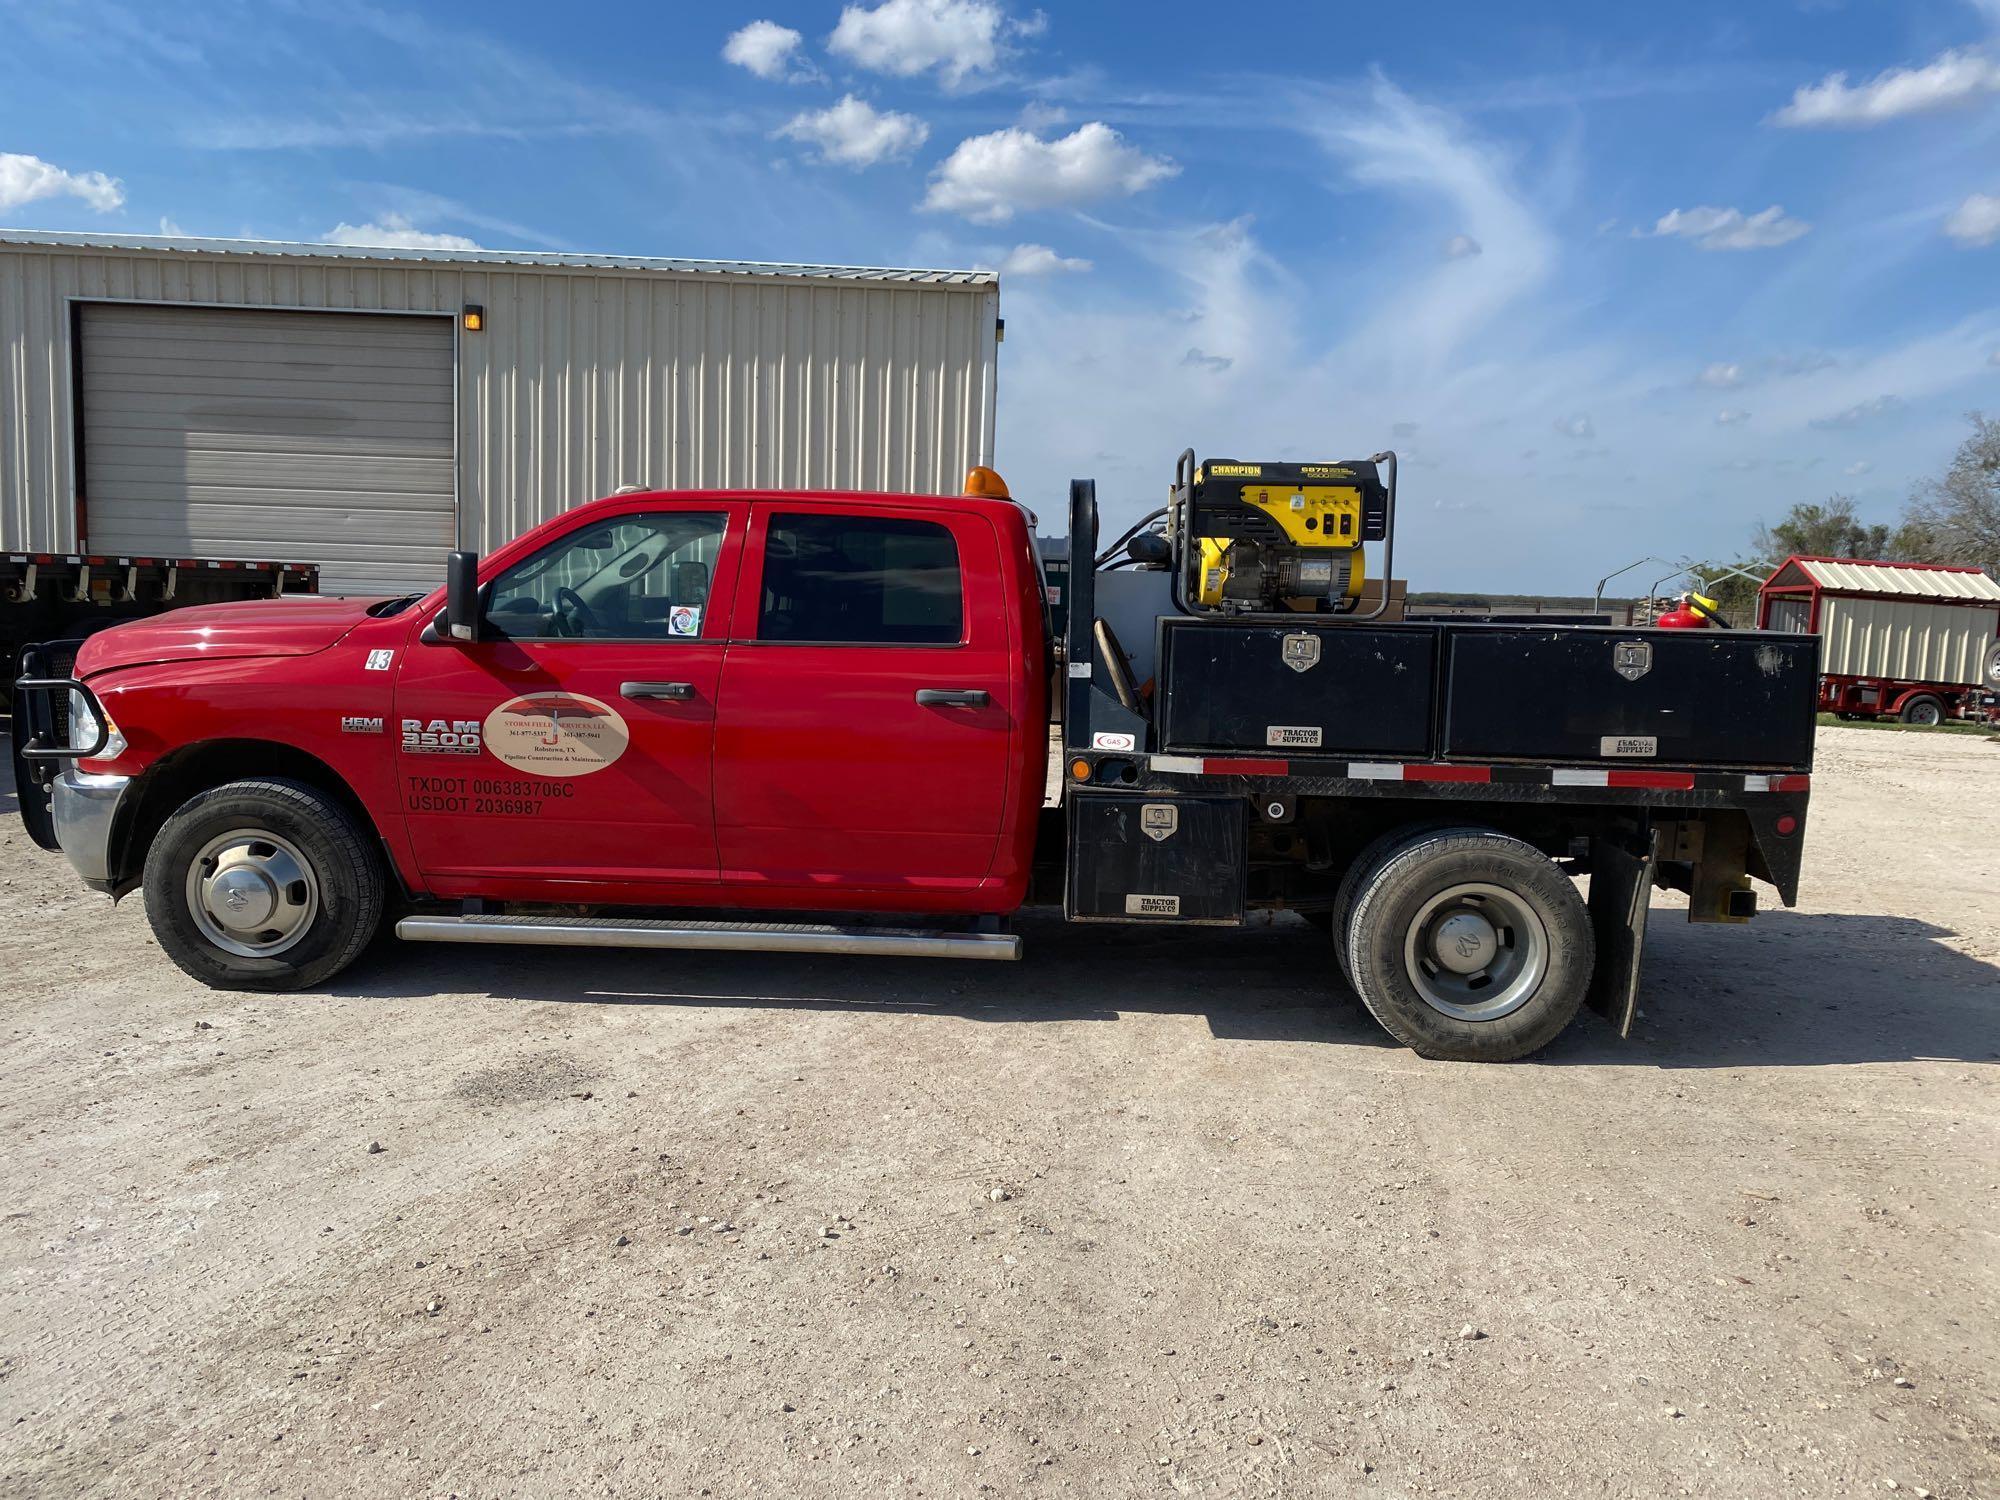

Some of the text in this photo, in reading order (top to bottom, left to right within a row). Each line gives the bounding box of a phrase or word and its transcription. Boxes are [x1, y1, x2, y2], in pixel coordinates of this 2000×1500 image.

[1212, 465, 1261, 475] CHAMPION
[367, 650, 391, 669] 43
[341, 716, 383, 727] HEMI
[402, 719, 480, 733] RAM
[402, 732, 480, 747] 3500
[1106, 738, 1121, 746] GAS
[408, 776, 574, 798] TXDOT 006383706C
[409, 795, 543, 815] USDOT 2036987
[1141, 898, 1176, 906] TRACTOR
